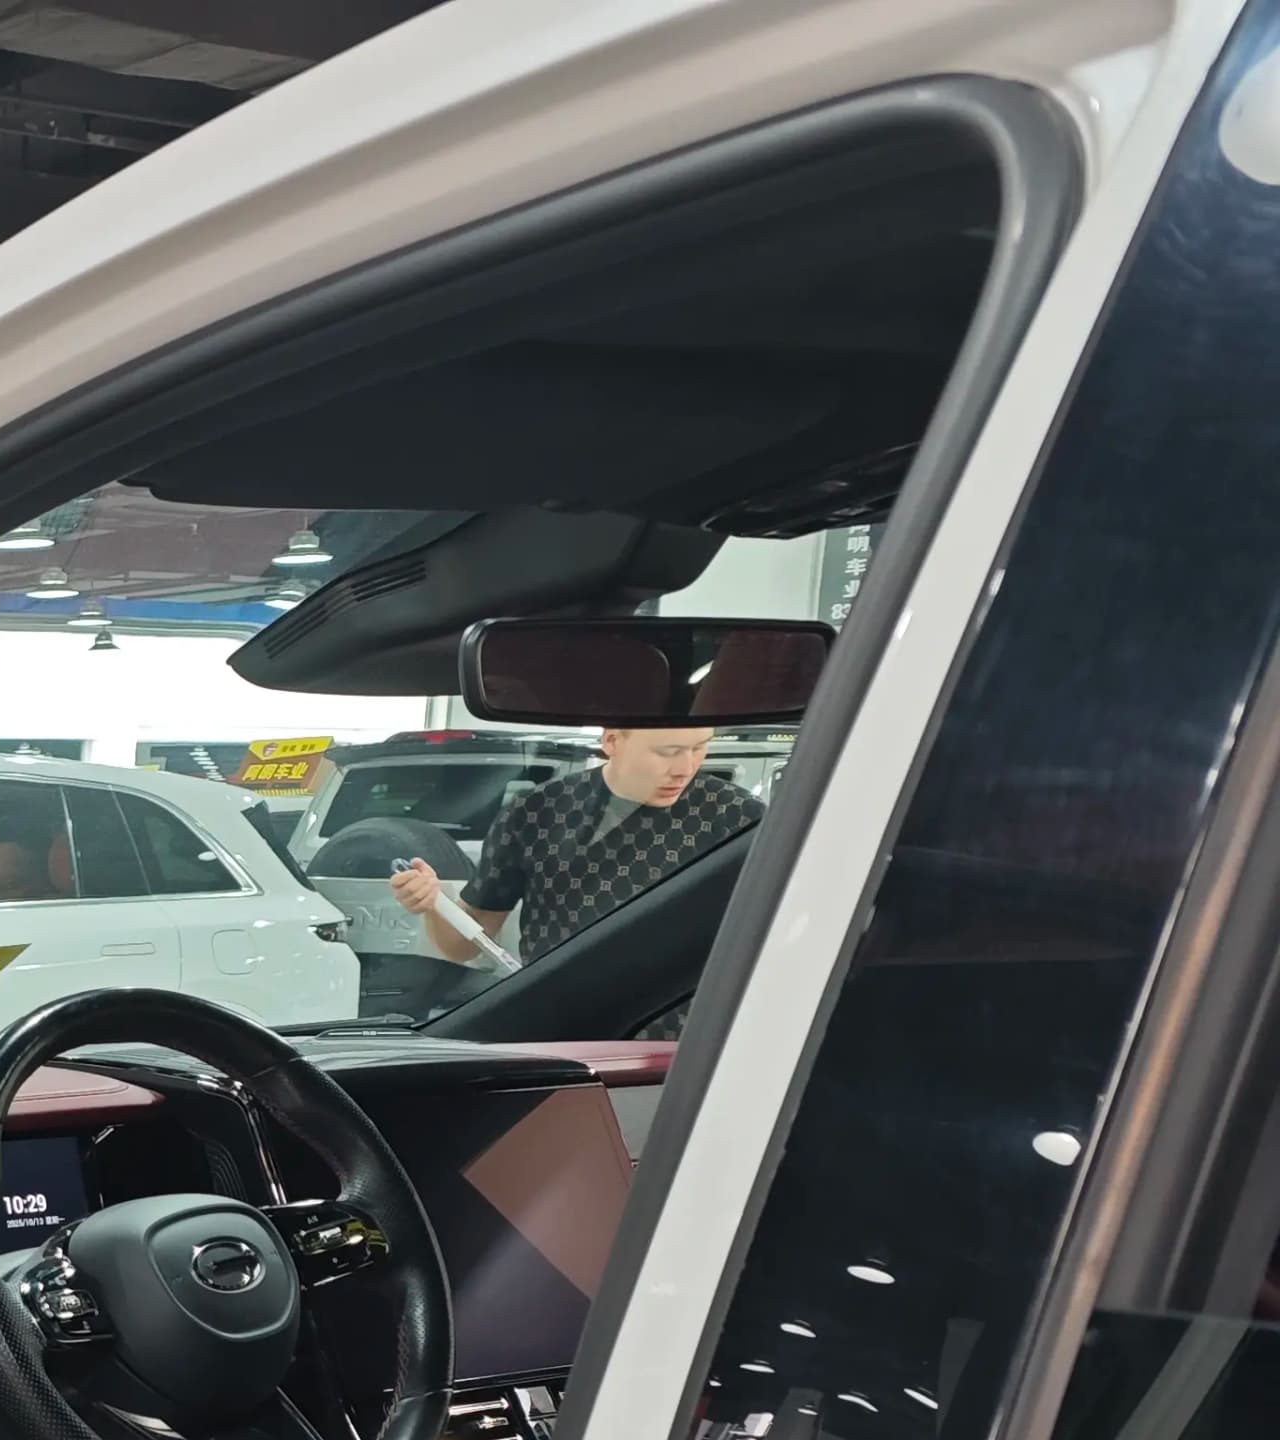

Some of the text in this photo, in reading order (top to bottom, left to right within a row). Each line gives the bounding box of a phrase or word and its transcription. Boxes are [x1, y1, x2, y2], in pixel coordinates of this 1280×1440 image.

[242, 762, 309, 781] 阿明车业
[3, 1193, 48, 1215] 10:29
